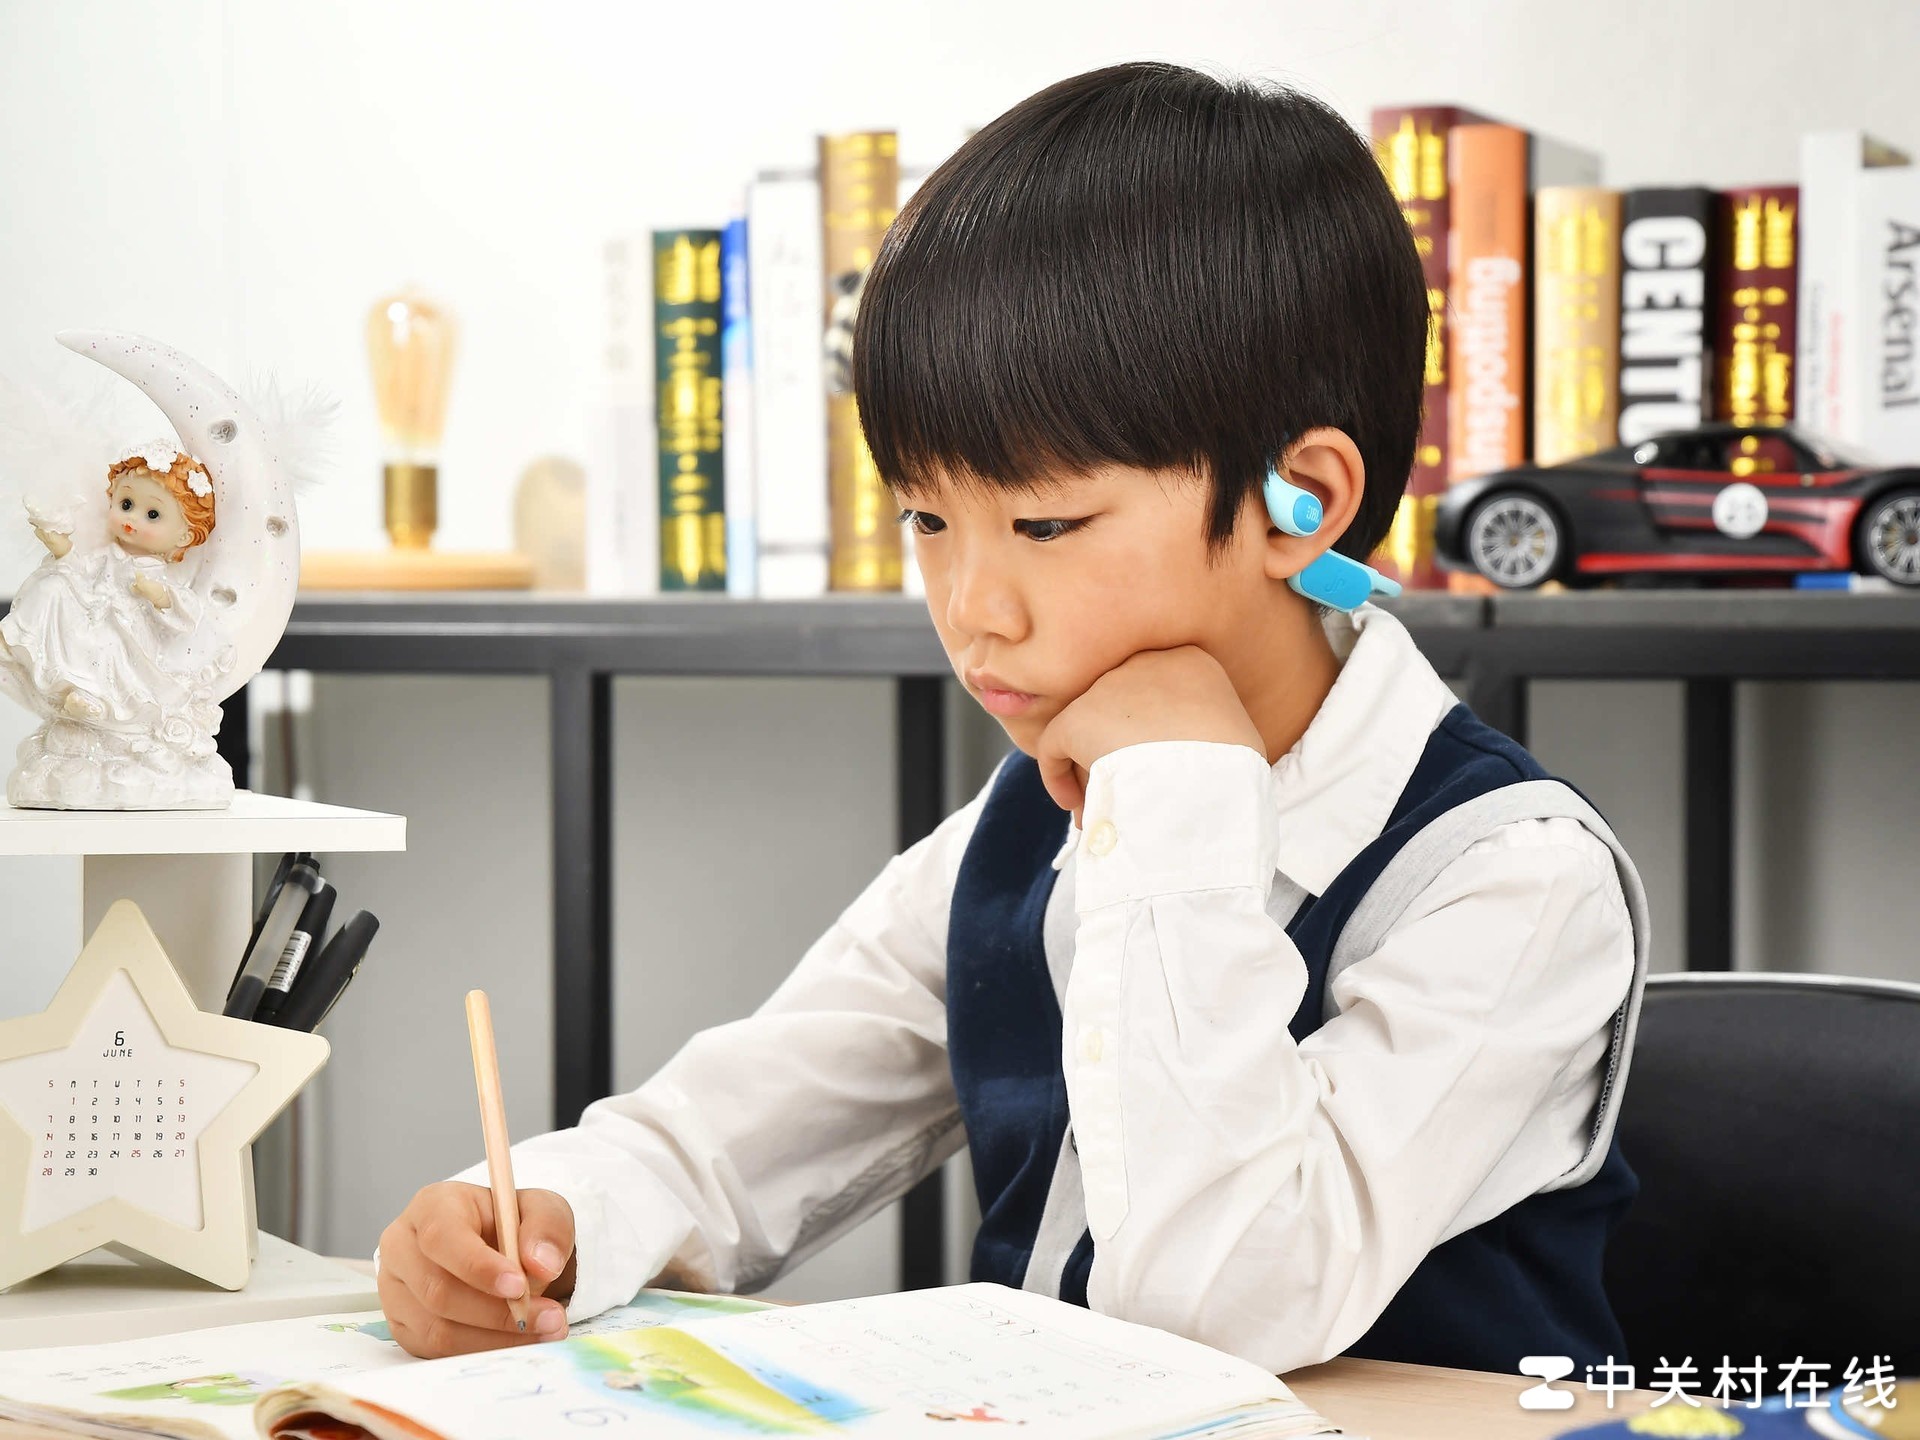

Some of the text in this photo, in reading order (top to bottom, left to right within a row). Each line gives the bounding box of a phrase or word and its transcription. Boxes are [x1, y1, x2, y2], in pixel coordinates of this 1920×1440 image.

[1883, 219, 1920, 409] Arsenal
[1306, 504, 1320, 524] JBL
[114, 1030, 125, 1047] 6
[103, 1048, 133, 1058] JUNE
[113, 1114, 121, 1124] 10
[135, 1114, 142, 1124] 11
[156, 1114, 164, 1124] 12
[177, 1114, 186, 1124] 13
[46, 1131, 186, 1142] 14 15 16 17 18 19 20
[43, 1149, 185, 1159] 21 22 23 24 25 26 27
[41, 1167, 98, 1177] 28 29 30
